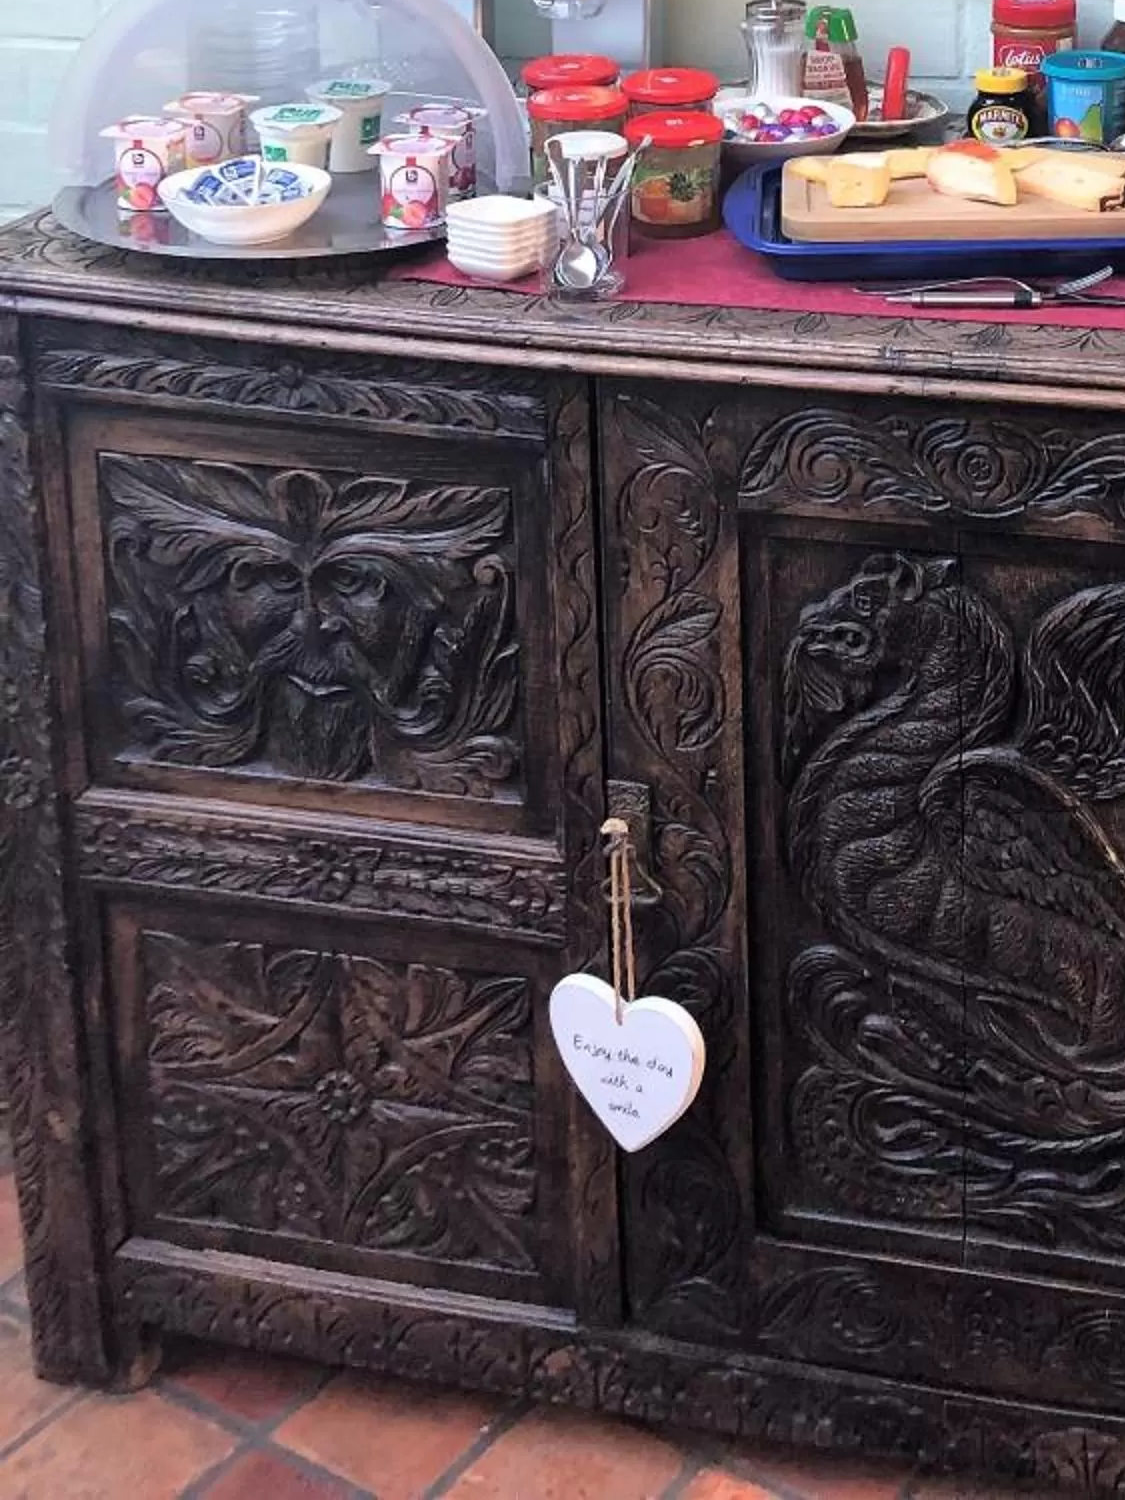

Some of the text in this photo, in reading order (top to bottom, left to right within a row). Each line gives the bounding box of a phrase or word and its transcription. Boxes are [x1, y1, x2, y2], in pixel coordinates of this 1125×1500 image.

[1005, 49, 1041, 67] Lotus
[573, 1034, 674, 1079] Enjoy the day
[600, 1074, 644, 1094] with a
